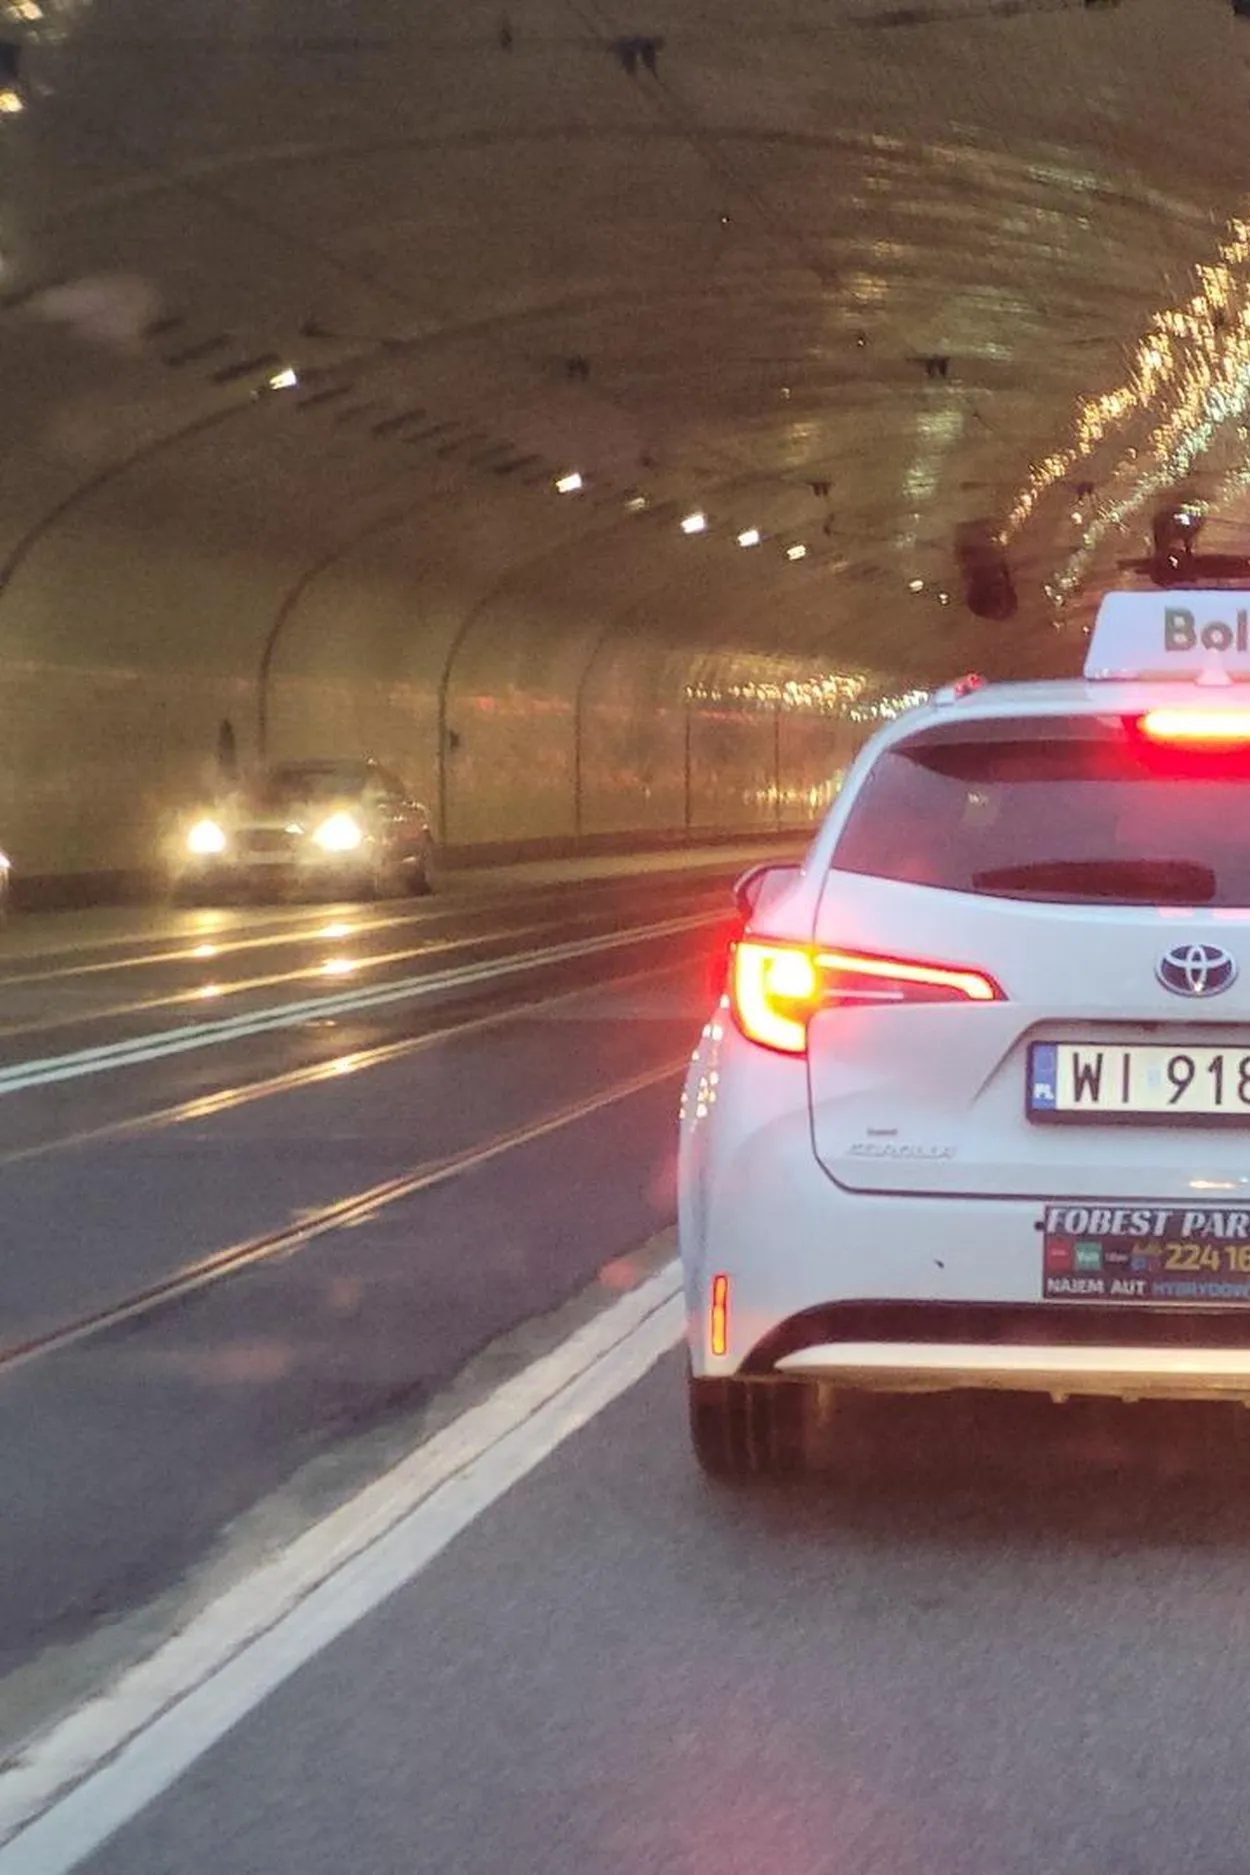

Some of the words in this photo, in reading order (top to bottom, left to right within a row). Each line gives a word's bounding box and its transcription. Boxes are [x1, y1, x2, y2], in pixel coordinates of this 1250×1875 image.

[1072, 1052, 1131, 1103] WI
[1047, 1208, 1172, 1236] FOBEST
[1164, 1243, 1219, 1271] 224
